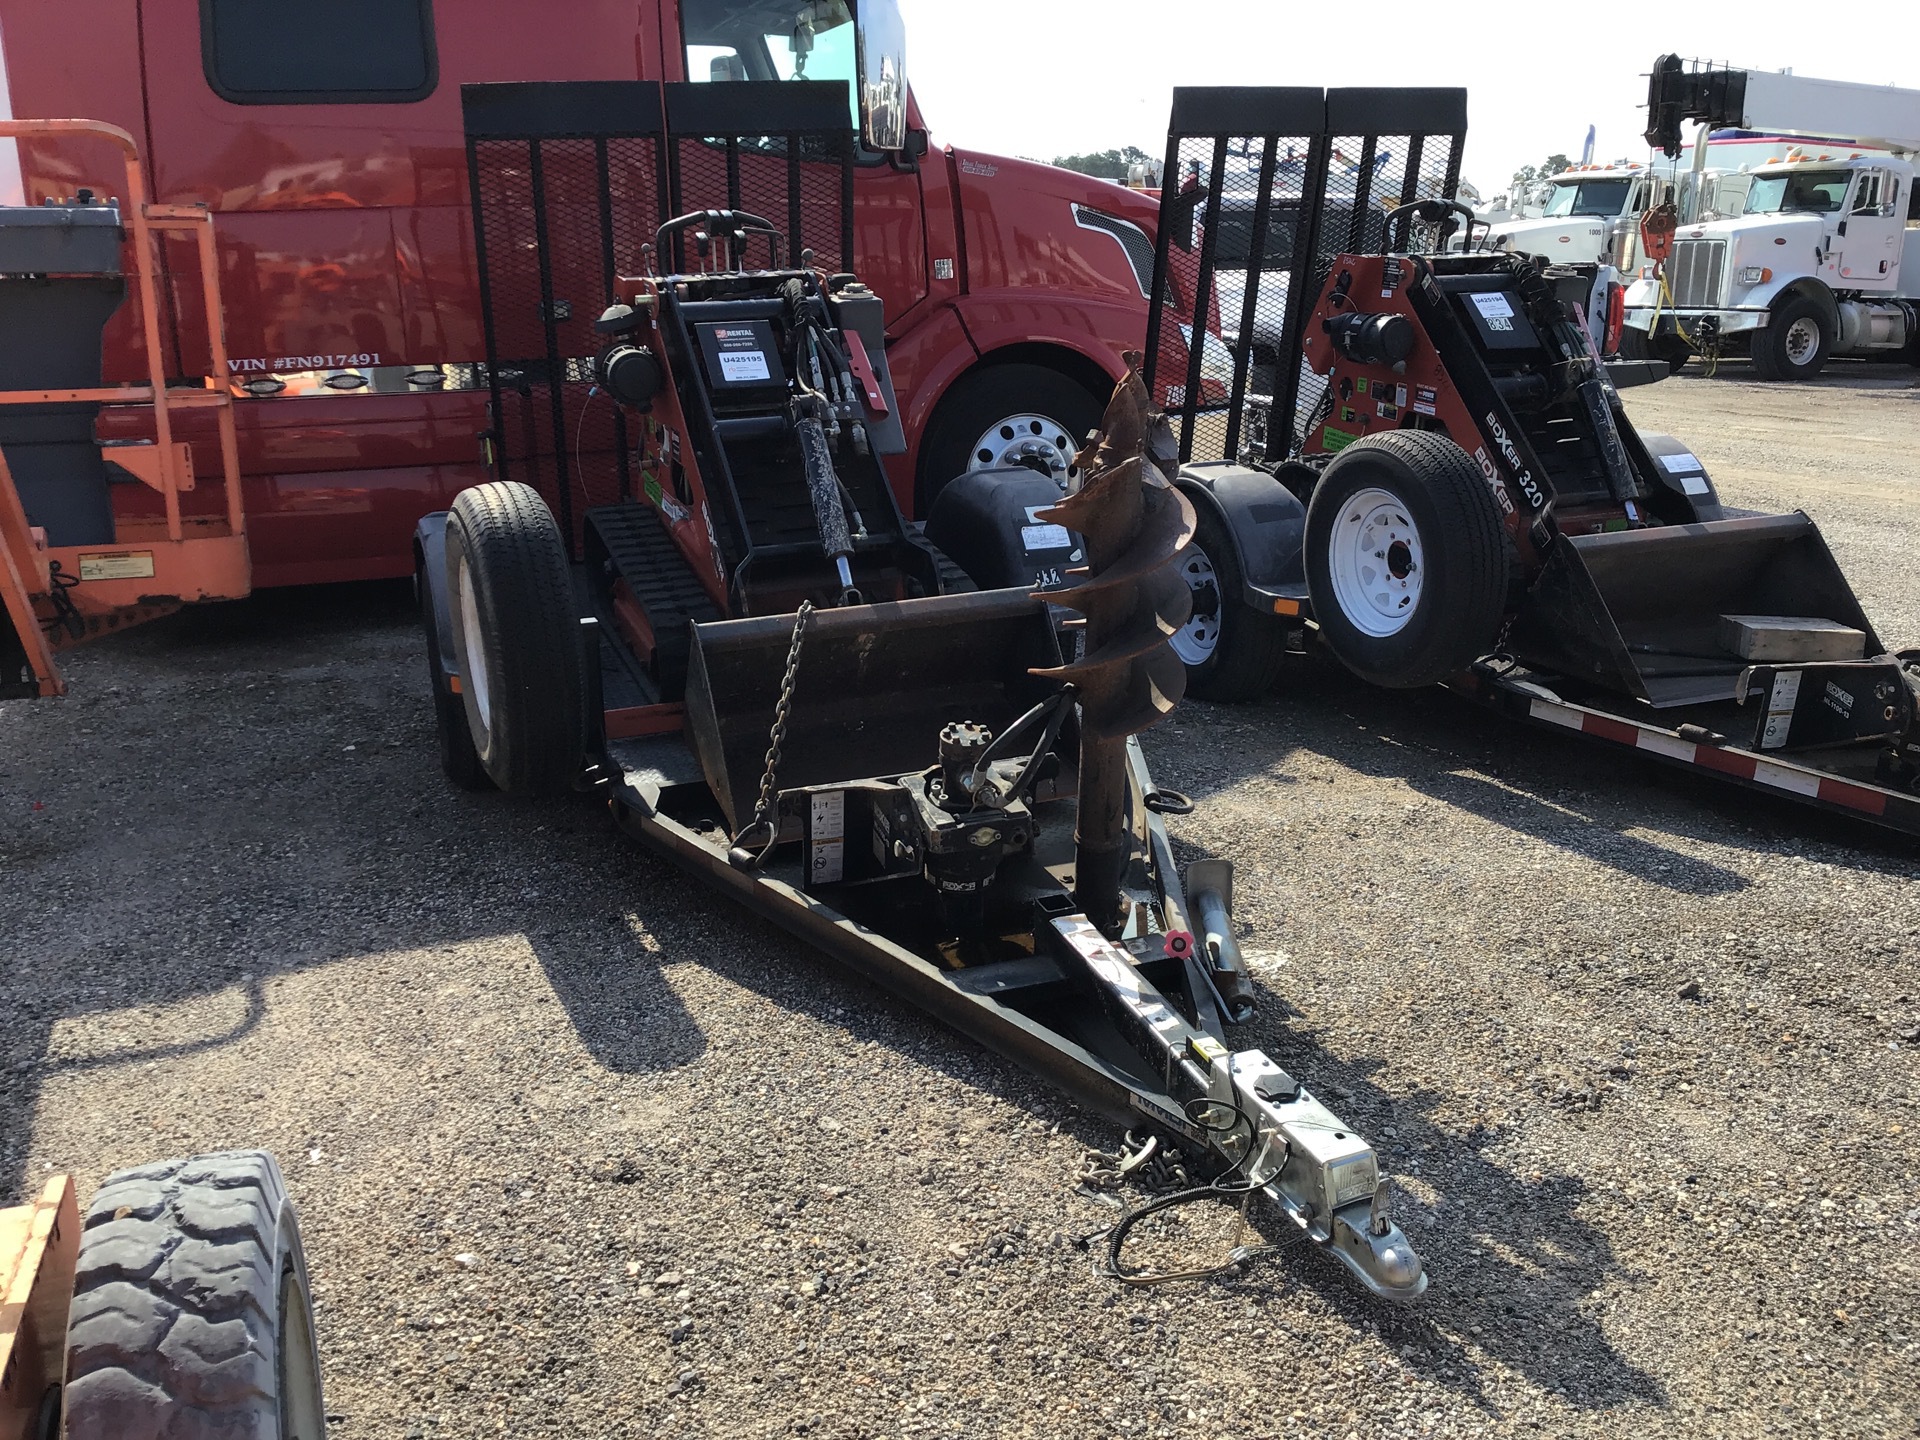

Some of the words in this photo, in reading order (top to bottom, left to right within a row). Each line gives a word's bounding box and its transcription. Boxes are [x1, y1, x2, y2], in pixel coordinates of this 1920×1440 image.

[727, 329, 754, 337] RENTAL
[1488, 319, 1511, 330] 834
[227, 359, 266, 371] VIN
[274, 353, 381, 369] #FN917491
[723, 355, 762, 363] U425195
[1485, 411, 1521, 471] BOXER
[1519, 470, 1543, 508] 320
[1474, 445, 1514, 515] BOXER
[1825, 681, 1854, 708] BOXER
